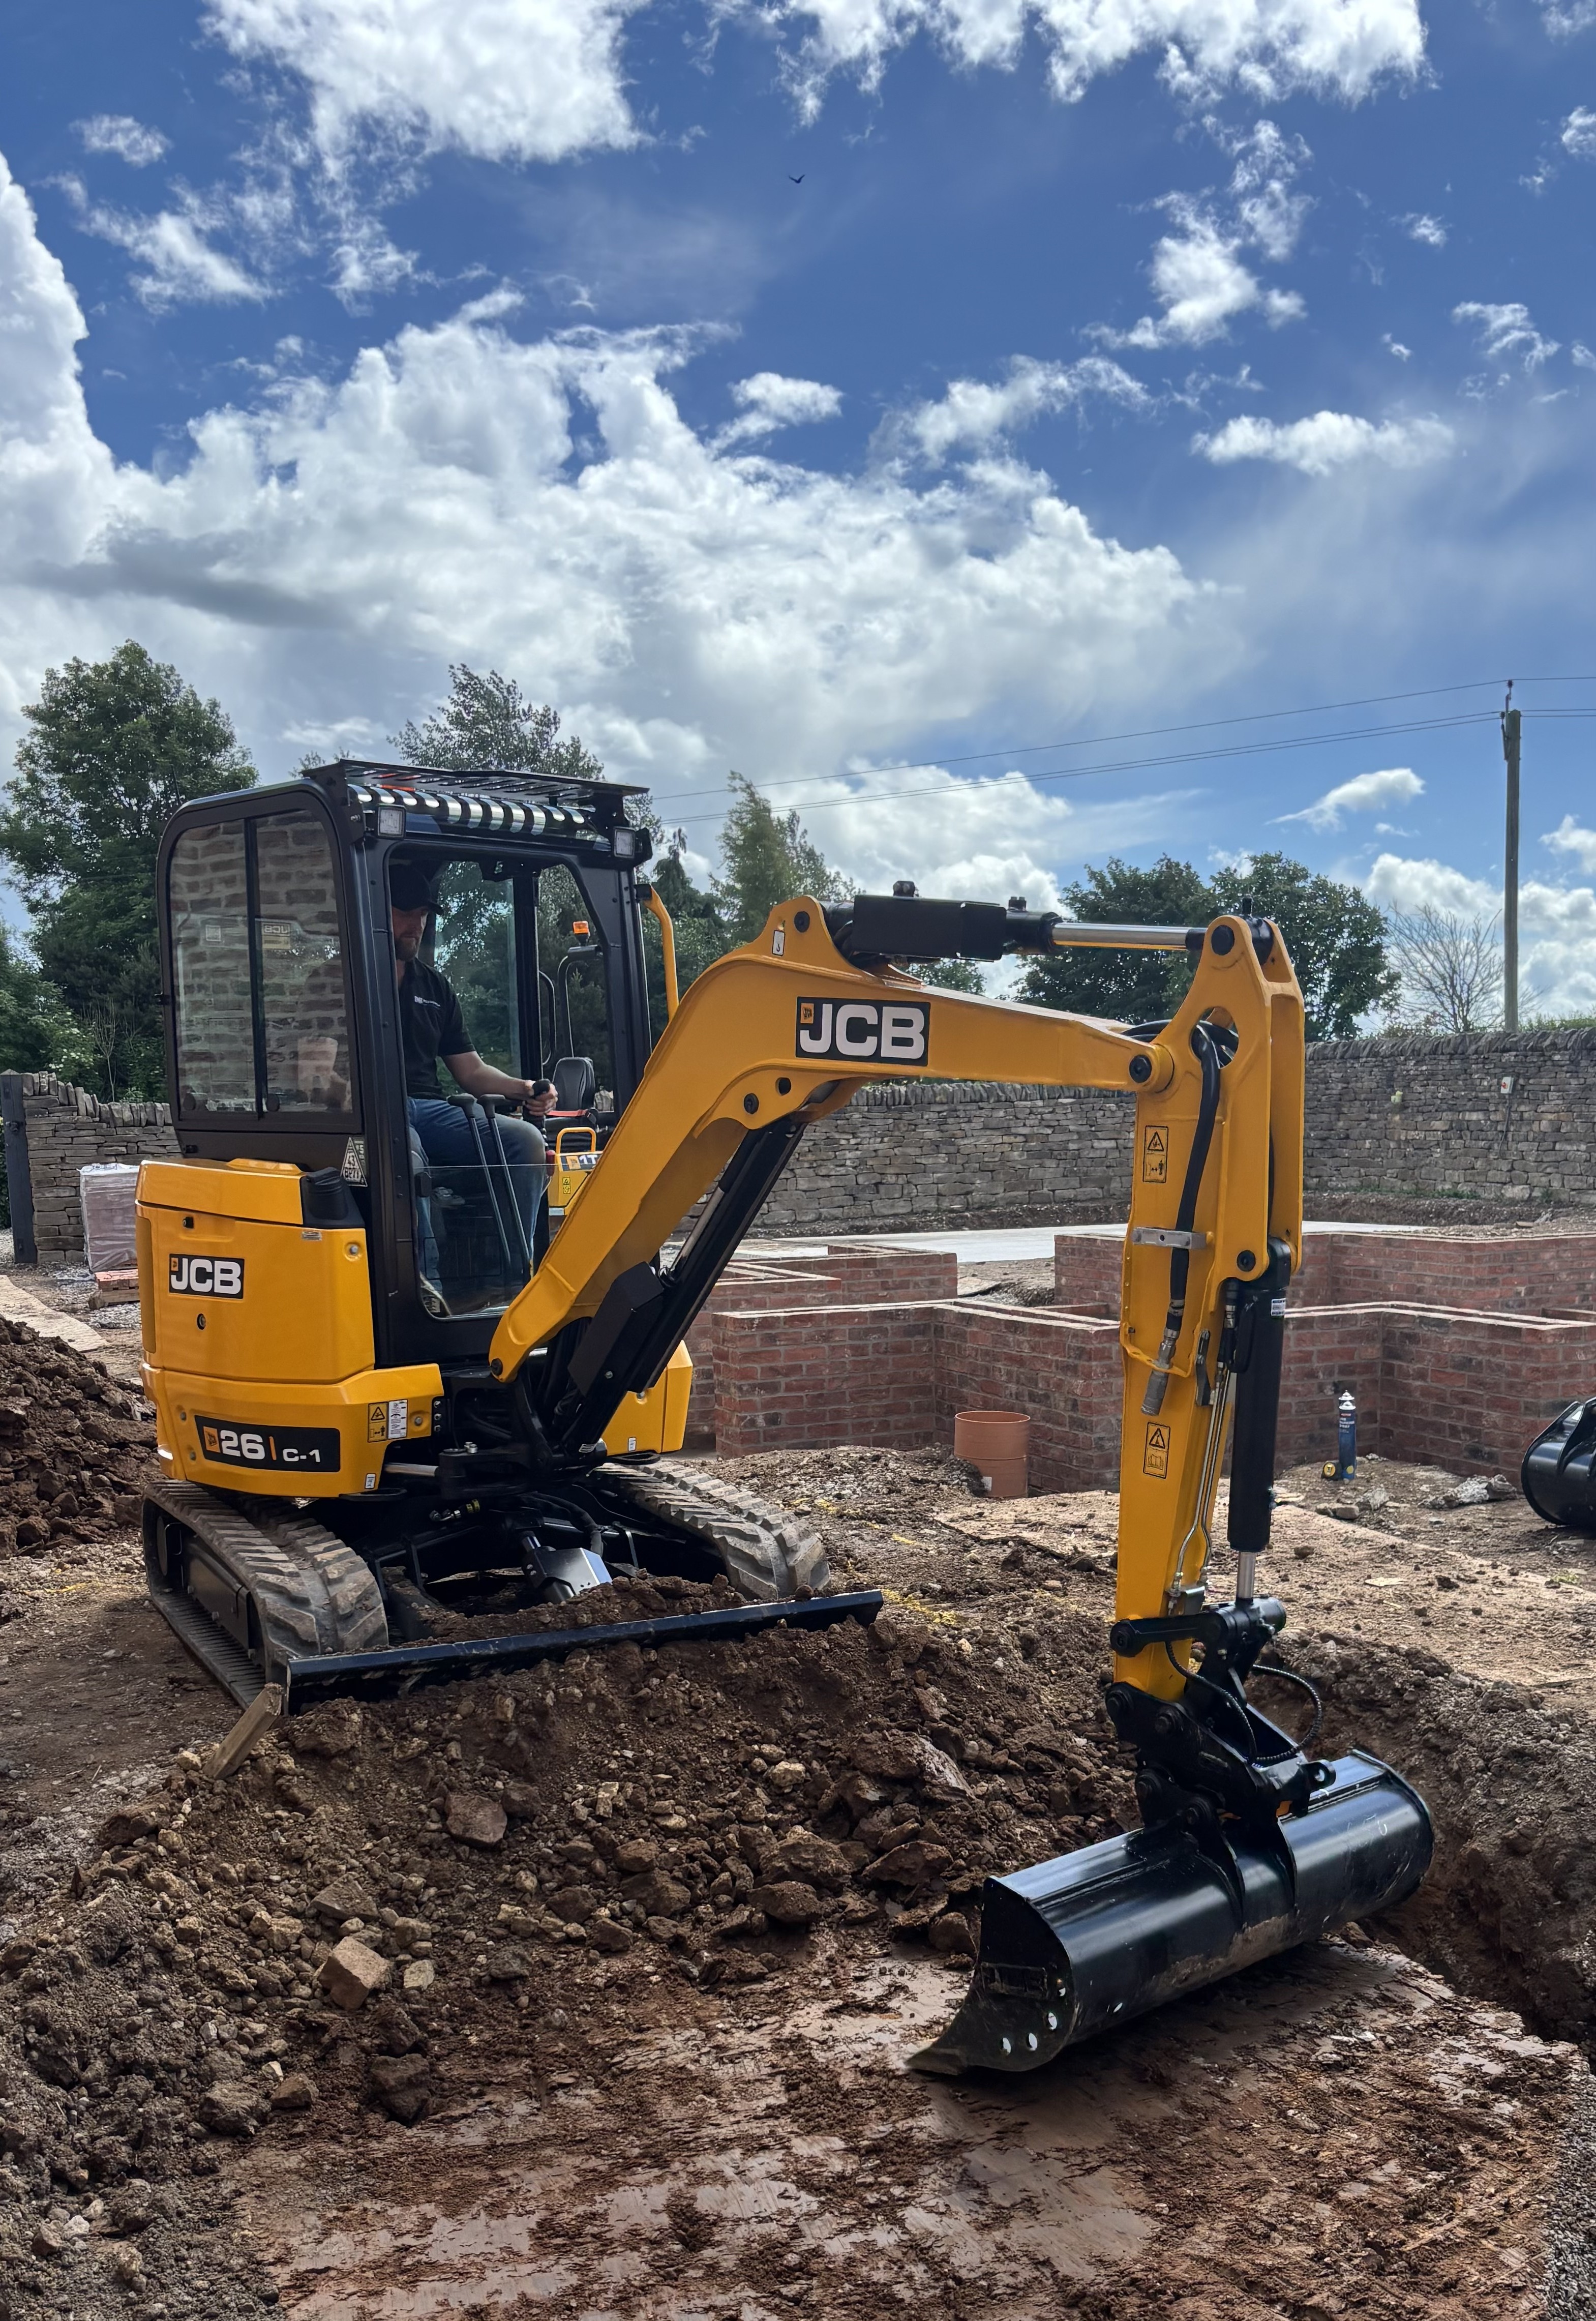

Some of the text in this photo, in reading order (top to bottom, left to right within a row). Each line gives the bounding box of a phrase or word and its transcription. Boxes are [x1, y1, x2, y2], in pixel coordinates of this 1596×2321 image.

[800, 1003, 924, 1059] JCB
[171, 1258, 241, 1294] JCB
[220, 1430, 265, 1460] 26
[283, 1448, 320, 1462] C-1
